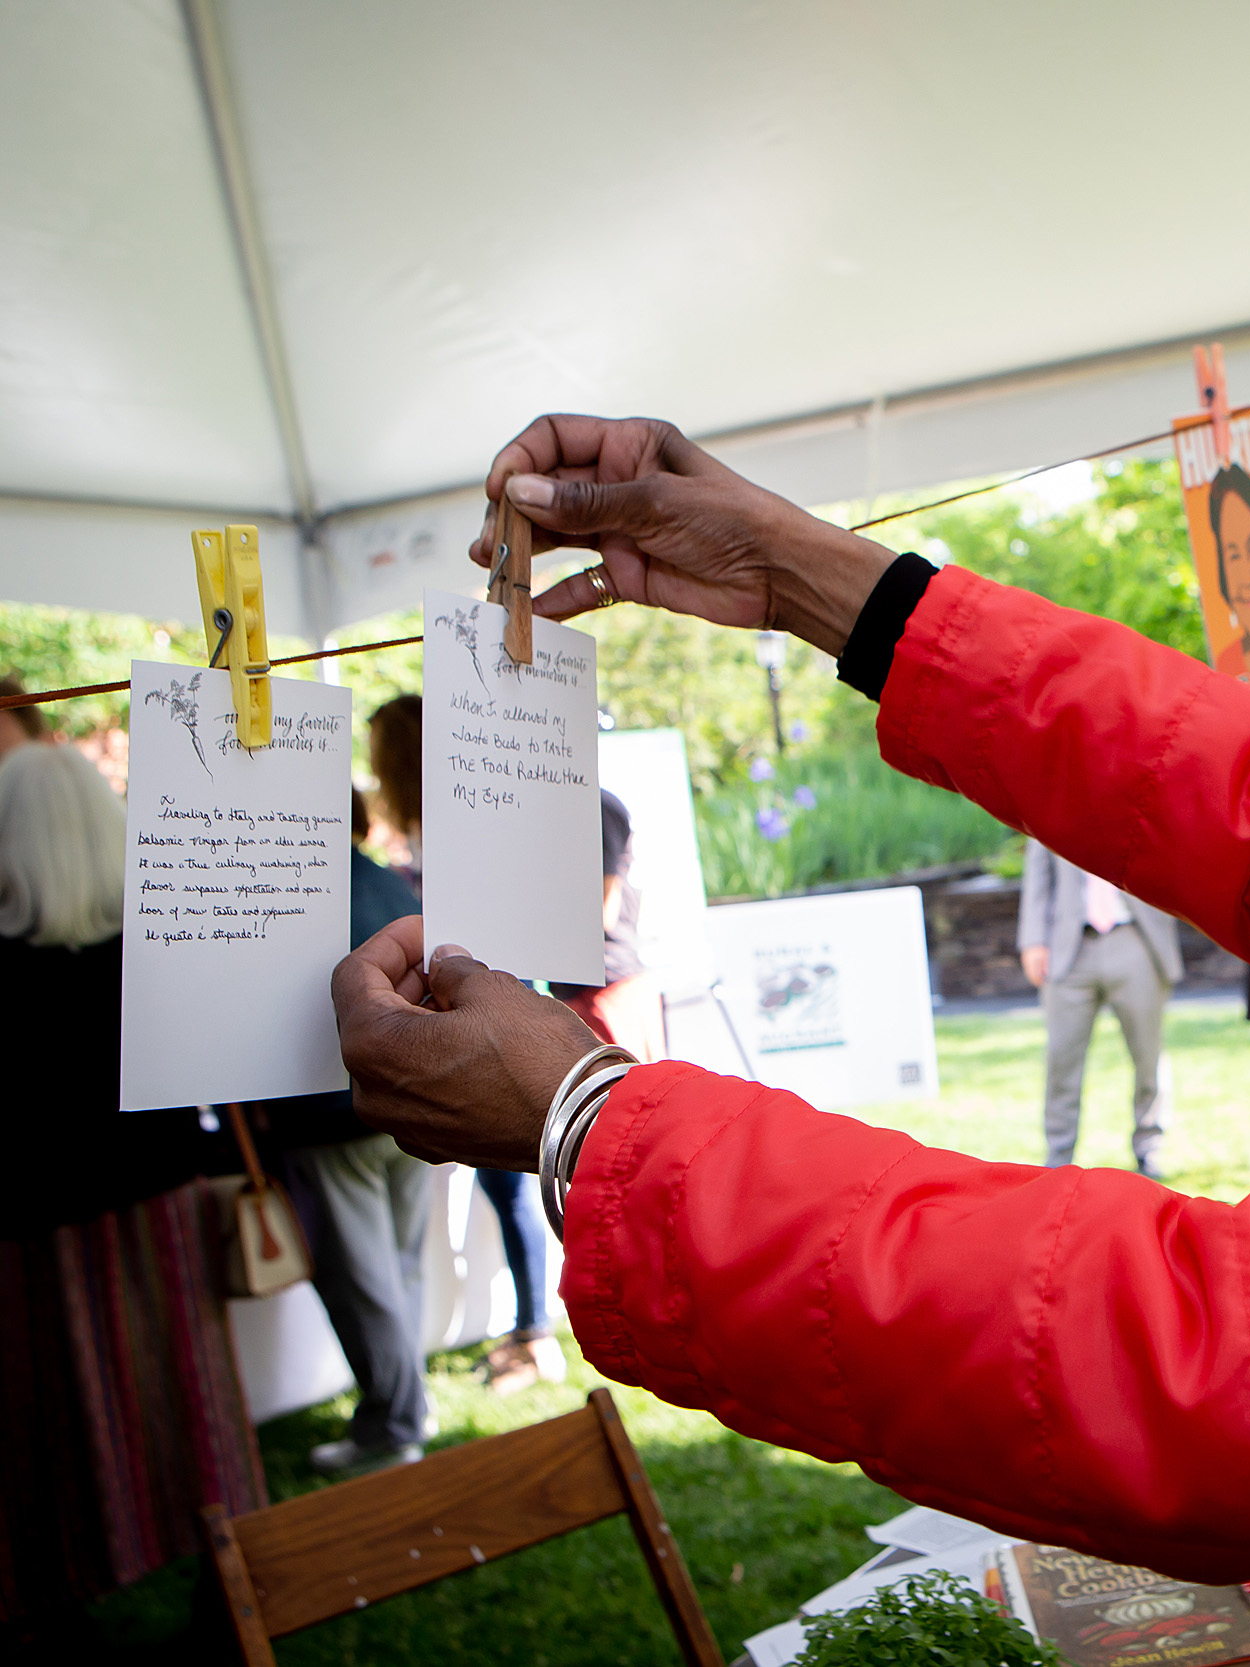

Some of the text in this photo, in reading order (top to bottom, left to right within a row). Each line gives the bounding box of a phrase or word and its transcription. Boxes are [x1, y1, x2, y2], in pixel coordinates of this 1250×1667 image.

[536, 649, 592, 676] my favorite
[450, 690, 485, 718] When
[502, 706, 548, 726] allowed
[553, 715, 567, 737] my
[273, 715, 293, 738] my
[296, 711, 346, 738] favorite
[493, 733, 521, 752] Buds
[528, 736, 540, 754] to
[481, 757, 512, 776] Food
[453, 783, 476, 810] My
[212, 805, 224, 821] to
[227, 807, 256, 831] Italy
[257, 810, 275, 823] and
[138, 857, 149, 870] It
[152, 861, 175, 870] was
[178, 862, 186, 870] a
[140, 879, 176, 895] flavor
[181, 884, 230, 898] surpasses
[284, 881, 301, 893] and
[138, 901, 166, 916] door
[168, 905, 180, 922] of
[182, 906, 208, 916] new
[241, 904, 260, 916] and
[162, 929, 194, 947] gusto
[1109, 1650, 1163, 1667] Jean
